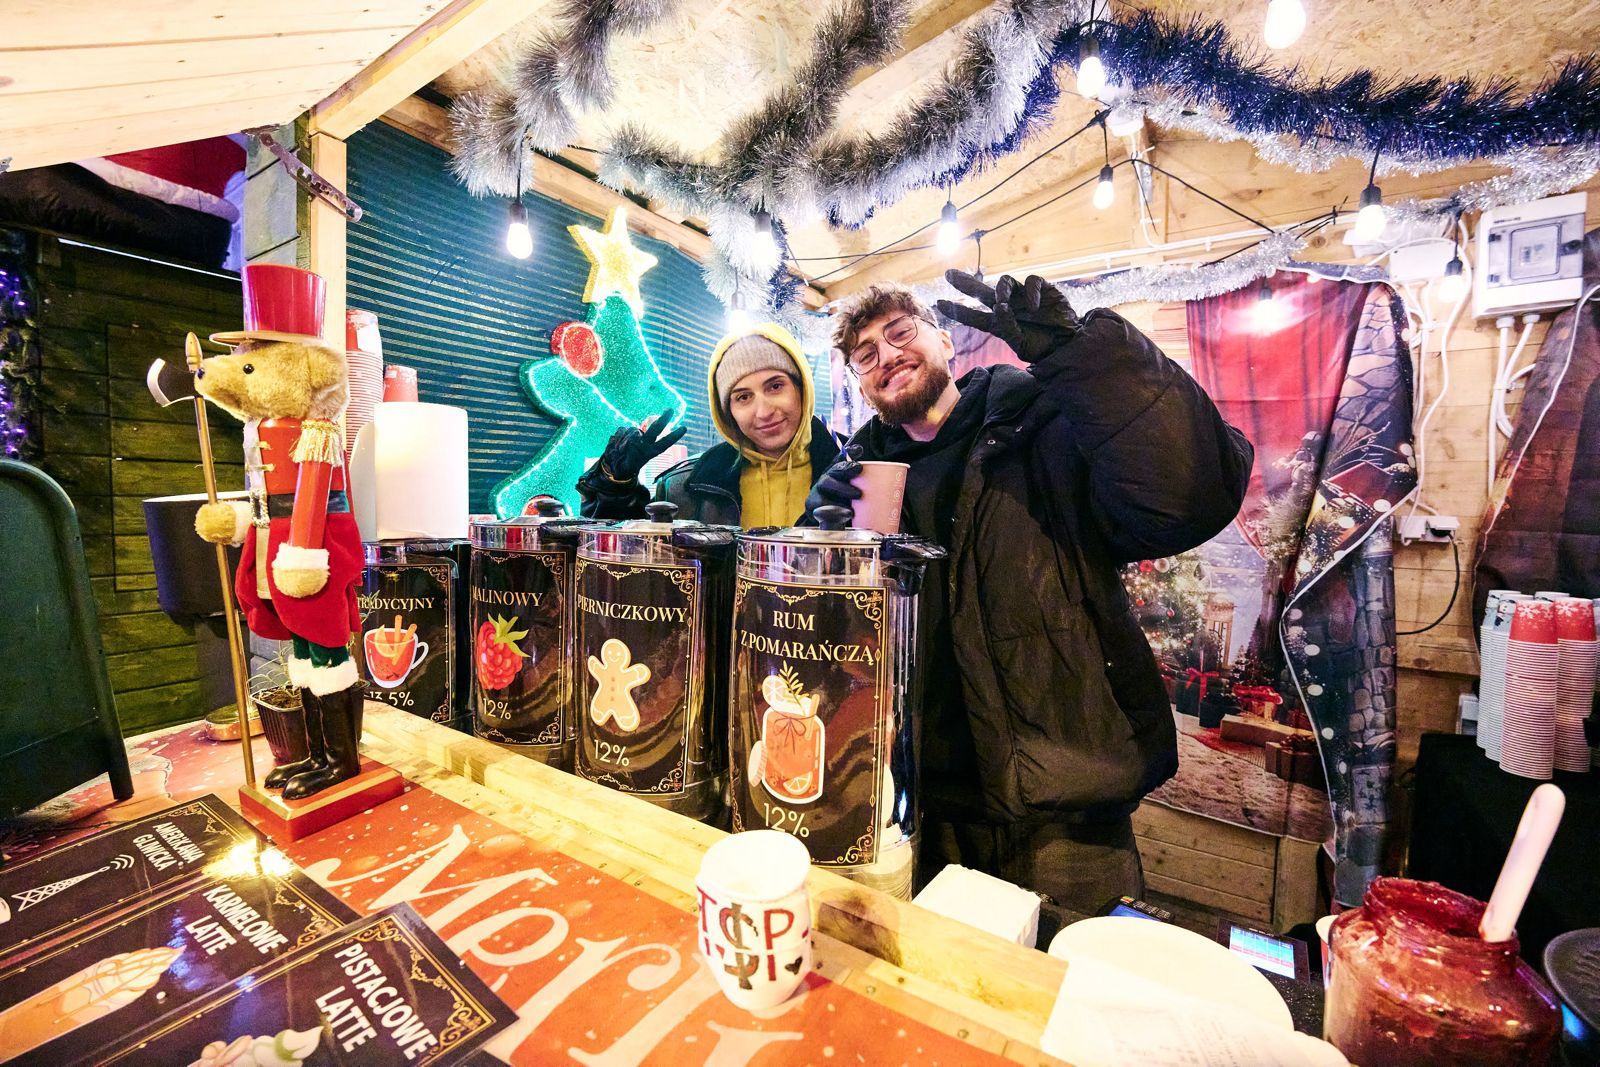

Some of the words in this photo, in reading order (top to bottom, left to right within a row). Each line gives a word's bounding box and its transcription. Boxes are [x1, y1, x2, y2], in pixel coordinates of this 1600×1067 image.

[472, 585, 543, 607] MALINOWY
[577, 594, 688, 623] PIERNICZKOWY
[773, 610, 816, 632] RUM
[749, 632, 874, 666] POMARAŃCZĄ
[482, 697, 512, 720] 12%
[594, 739, 630, 767] 12%
[763, 802, 810, 838] 12%
[132, 833, 178, 872] GLIWICKA
[184, 914, 237, 956] LATTE
[202, 884, 289, 954] KARMELOWE
[315, 985, 378, 1052] LATTE
[334, 942, 438, 1060] PISTACJOWE
